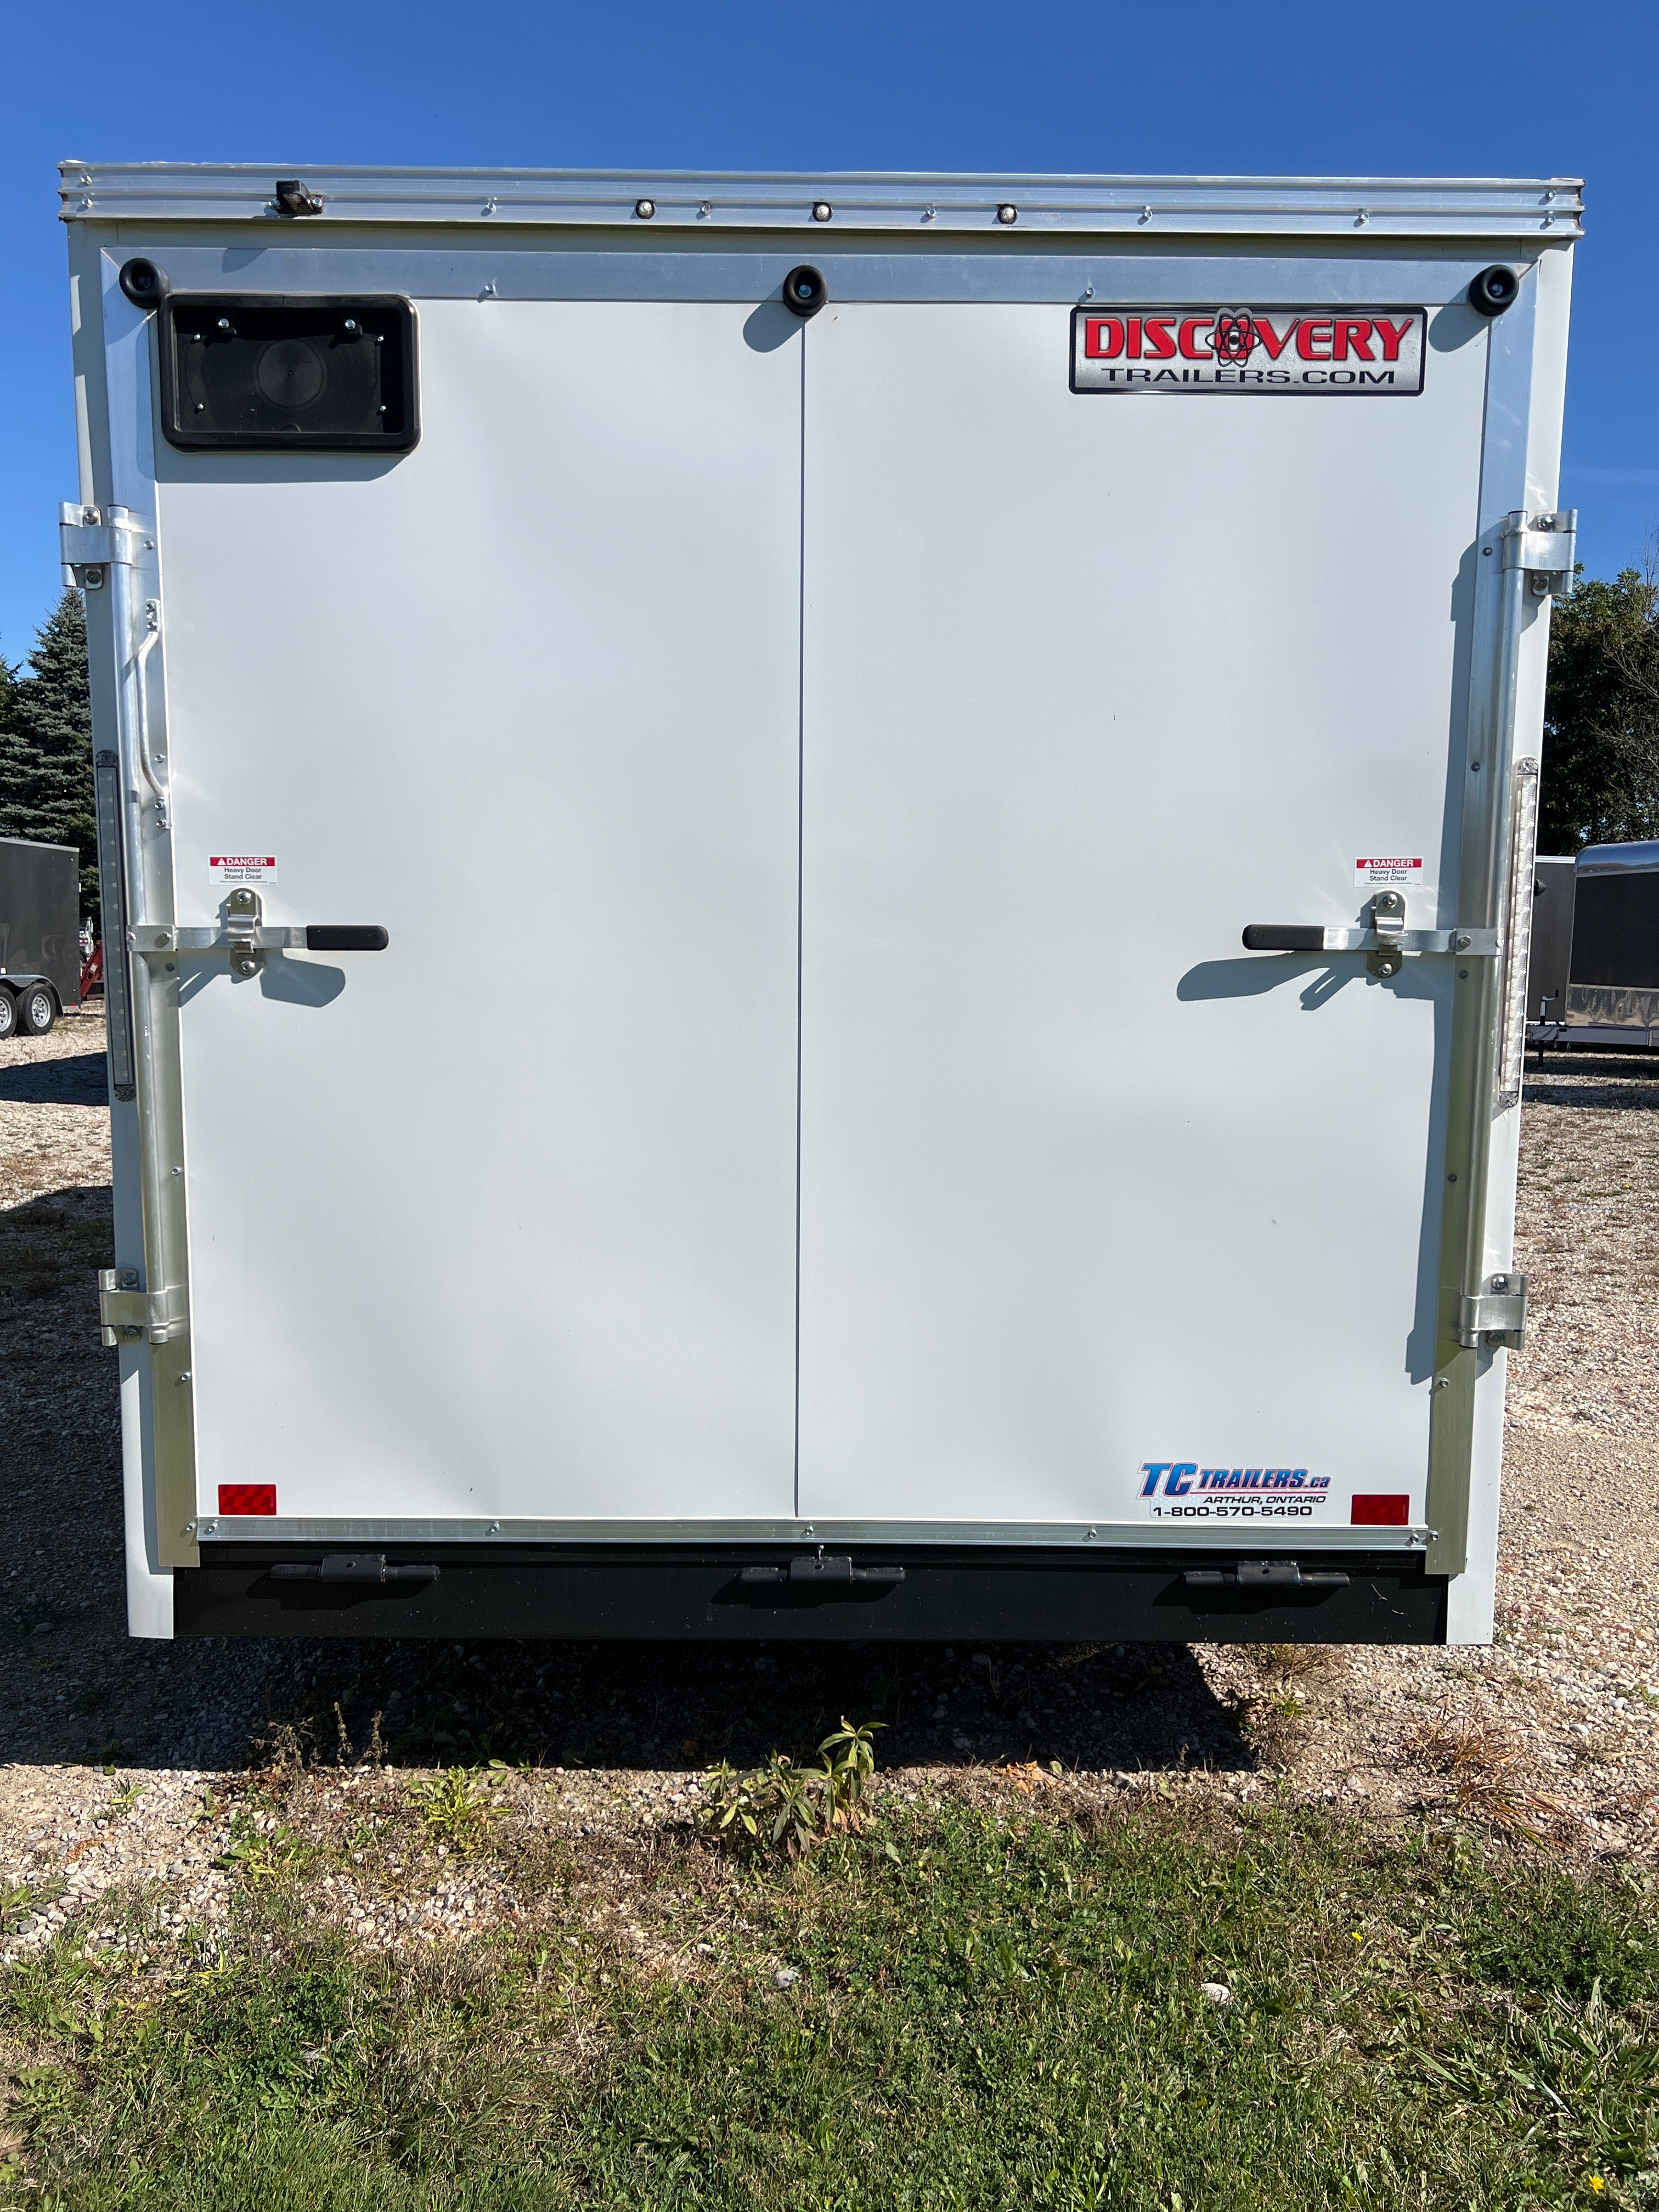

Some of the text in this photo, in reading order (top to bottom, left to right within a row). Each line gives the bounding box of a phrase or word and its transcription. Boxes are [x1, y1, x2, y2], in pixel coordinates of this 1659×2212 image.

[1084, 317, 1414, 361] DISCOVERY
[1101, 368, 1394, 385] TRAILERS.COM
[1140, 1462, 1331, 1497] TC TRAILERS.ca
[1203, 1495, 1327, 1505] ARTHUR, ONTARIO
[1153, 1506, 1313, 1517] 1-800-570-5490
